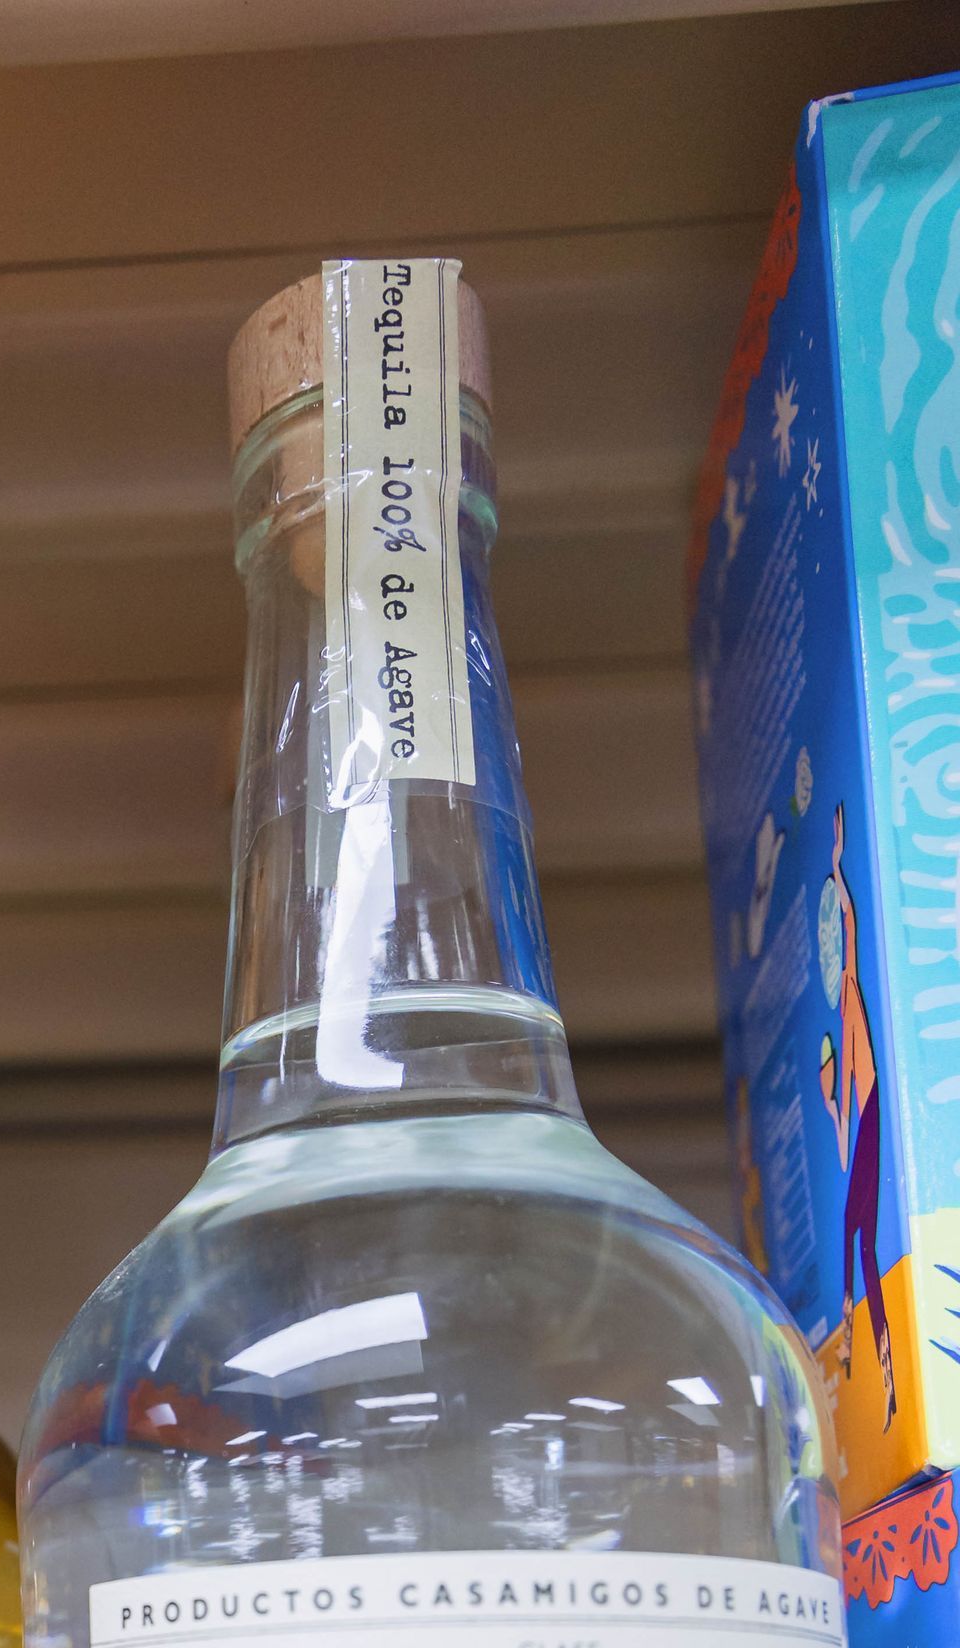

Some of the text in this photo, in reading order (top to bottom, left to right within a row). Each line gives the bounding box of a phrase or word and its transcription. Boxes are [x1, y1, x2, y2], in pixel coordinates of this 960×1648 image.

[372, 263, 427, 760] Tequila 100% de Agave
[121, 1582, 830, 1629] PRODUCTOS CASAMIGOS DE AGAVE
